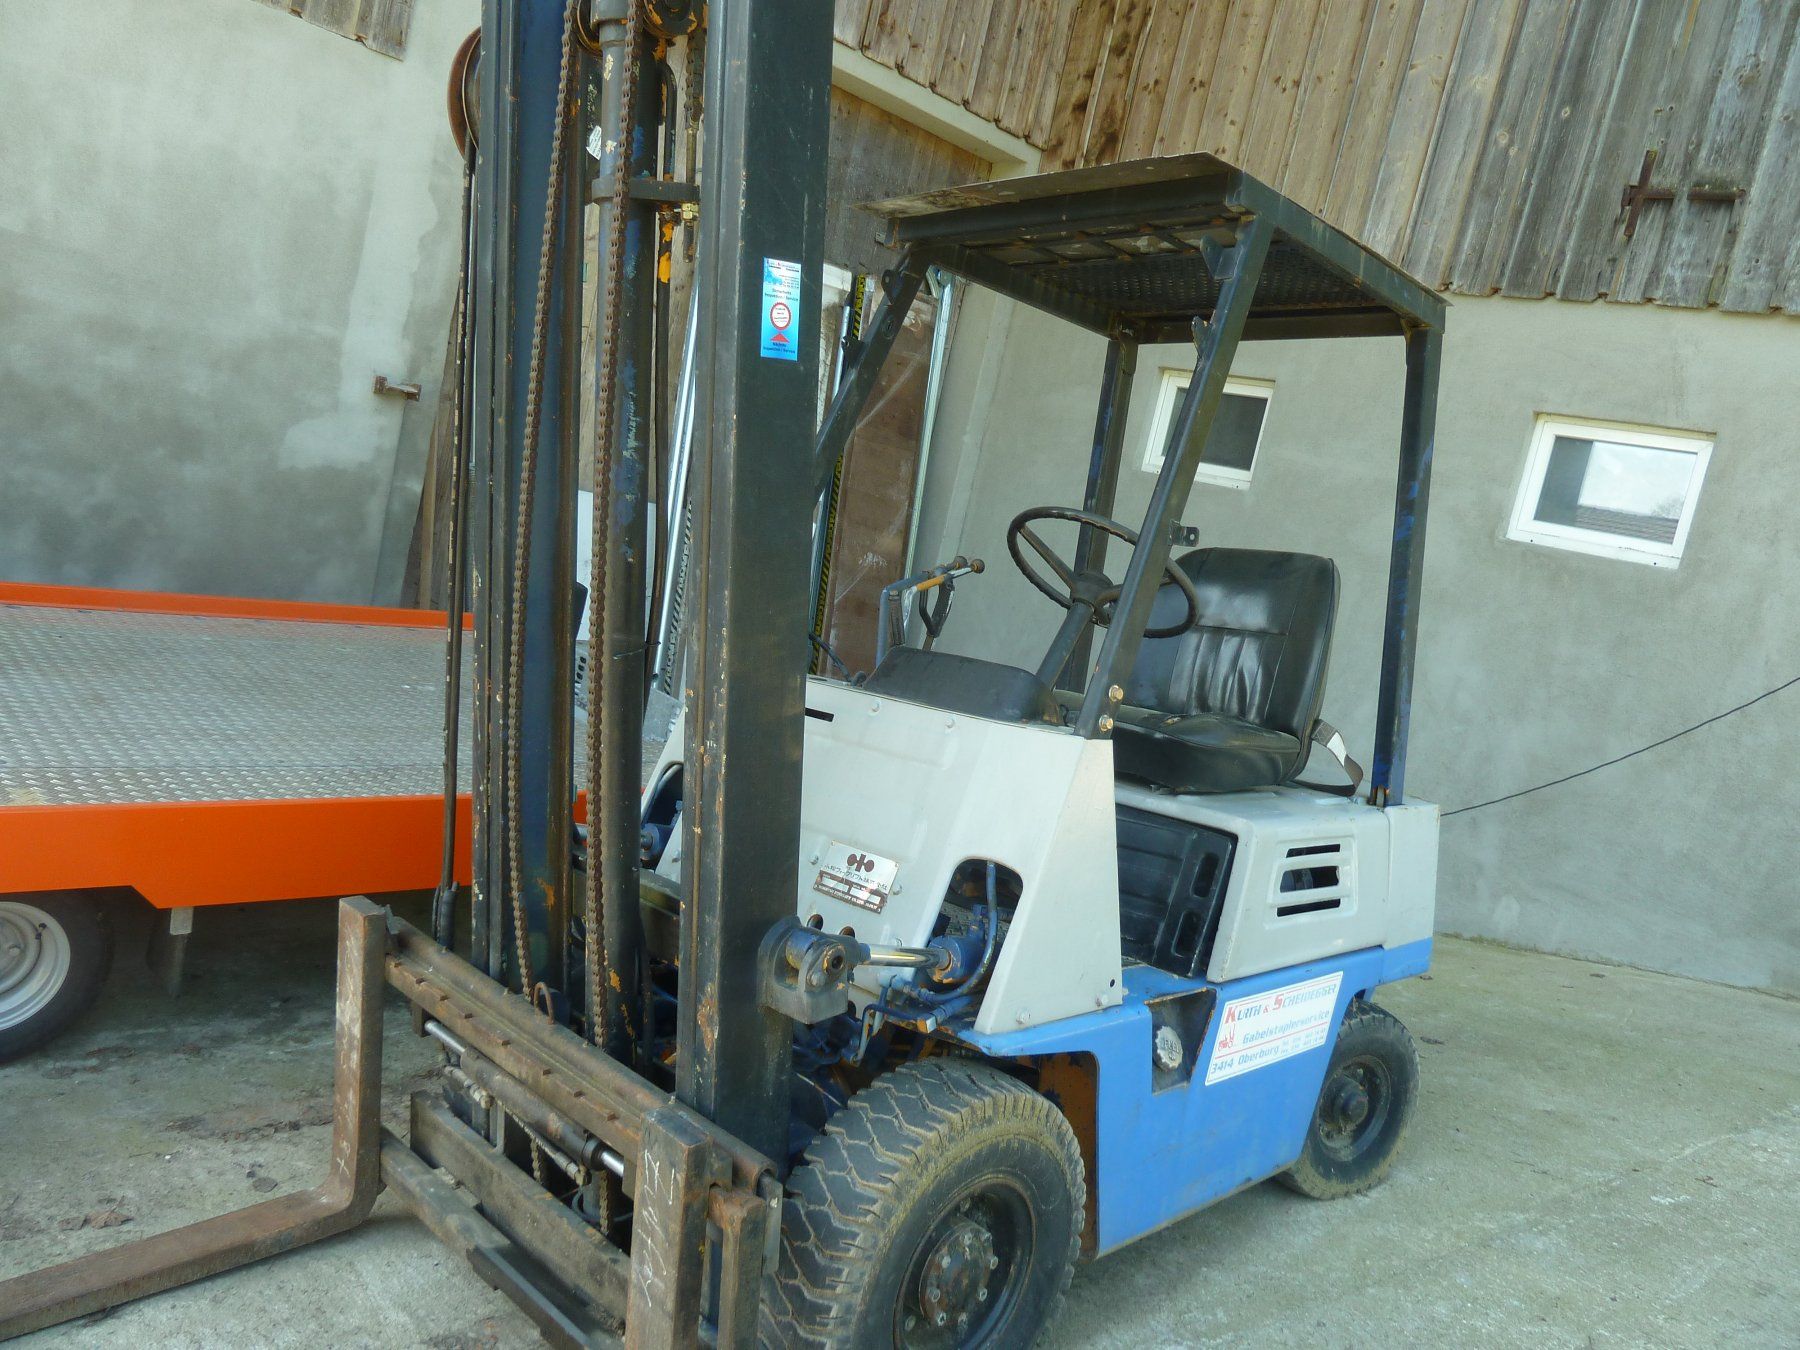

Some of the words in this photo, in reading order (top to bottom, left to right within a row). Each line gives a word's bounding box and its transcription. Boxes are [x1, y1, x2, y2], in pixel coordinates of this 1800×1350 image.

[1263, 1005, 1270, 1014] &
[1243, 1009, 1330, 1045] Gabelstaplerservice
[1210, 1059, 1234, 1075] 3414
[1238, 1046, 1280, 1066] Oberburg
